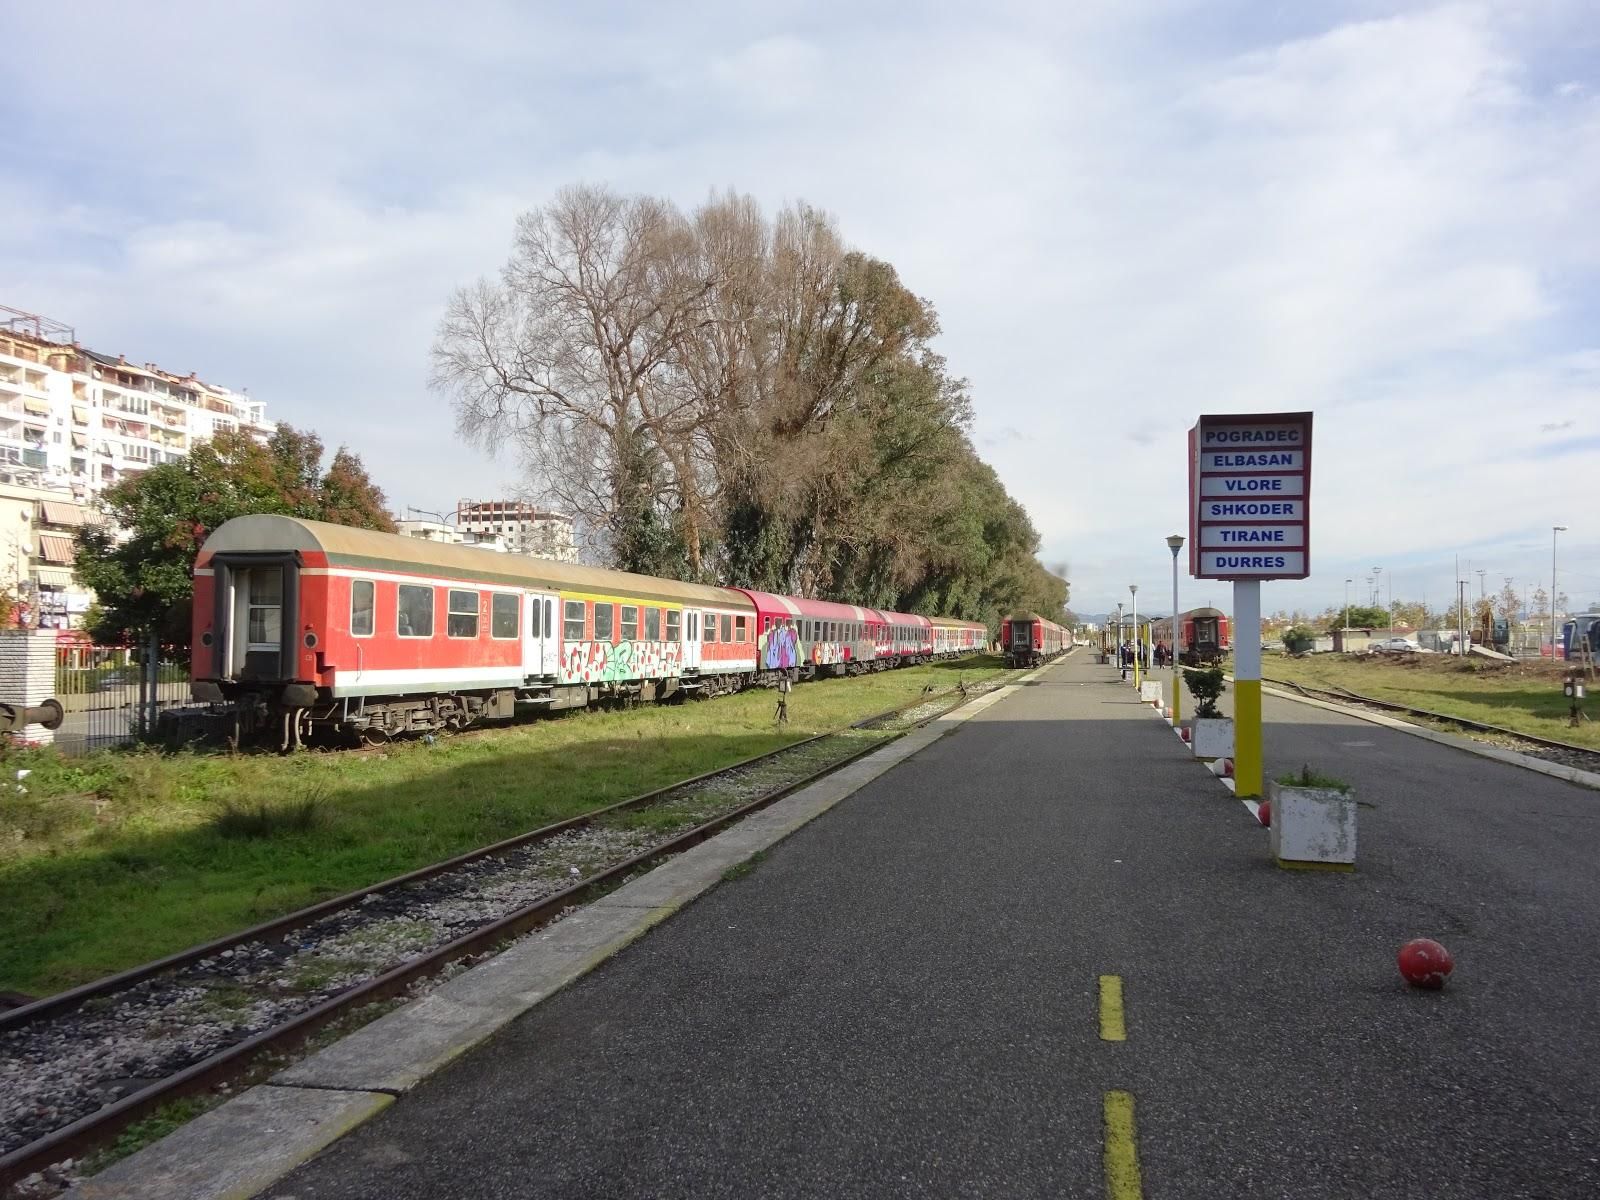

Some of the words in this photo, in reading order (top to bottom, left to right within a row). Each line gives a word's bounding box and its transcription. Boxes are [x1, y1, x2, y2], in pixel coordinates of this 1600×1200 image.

[1206, 430, 1299, 443] POGRADEC
[1214, 454, 1293, 466] ELBASAN
[1225, 479, 1282, 491] VLORE
[1211, 504, 1294, 516] SHKODER
[1220, 530, 1284, 542] TIRANE
[1216, 556, 1285, 568] DURRES
